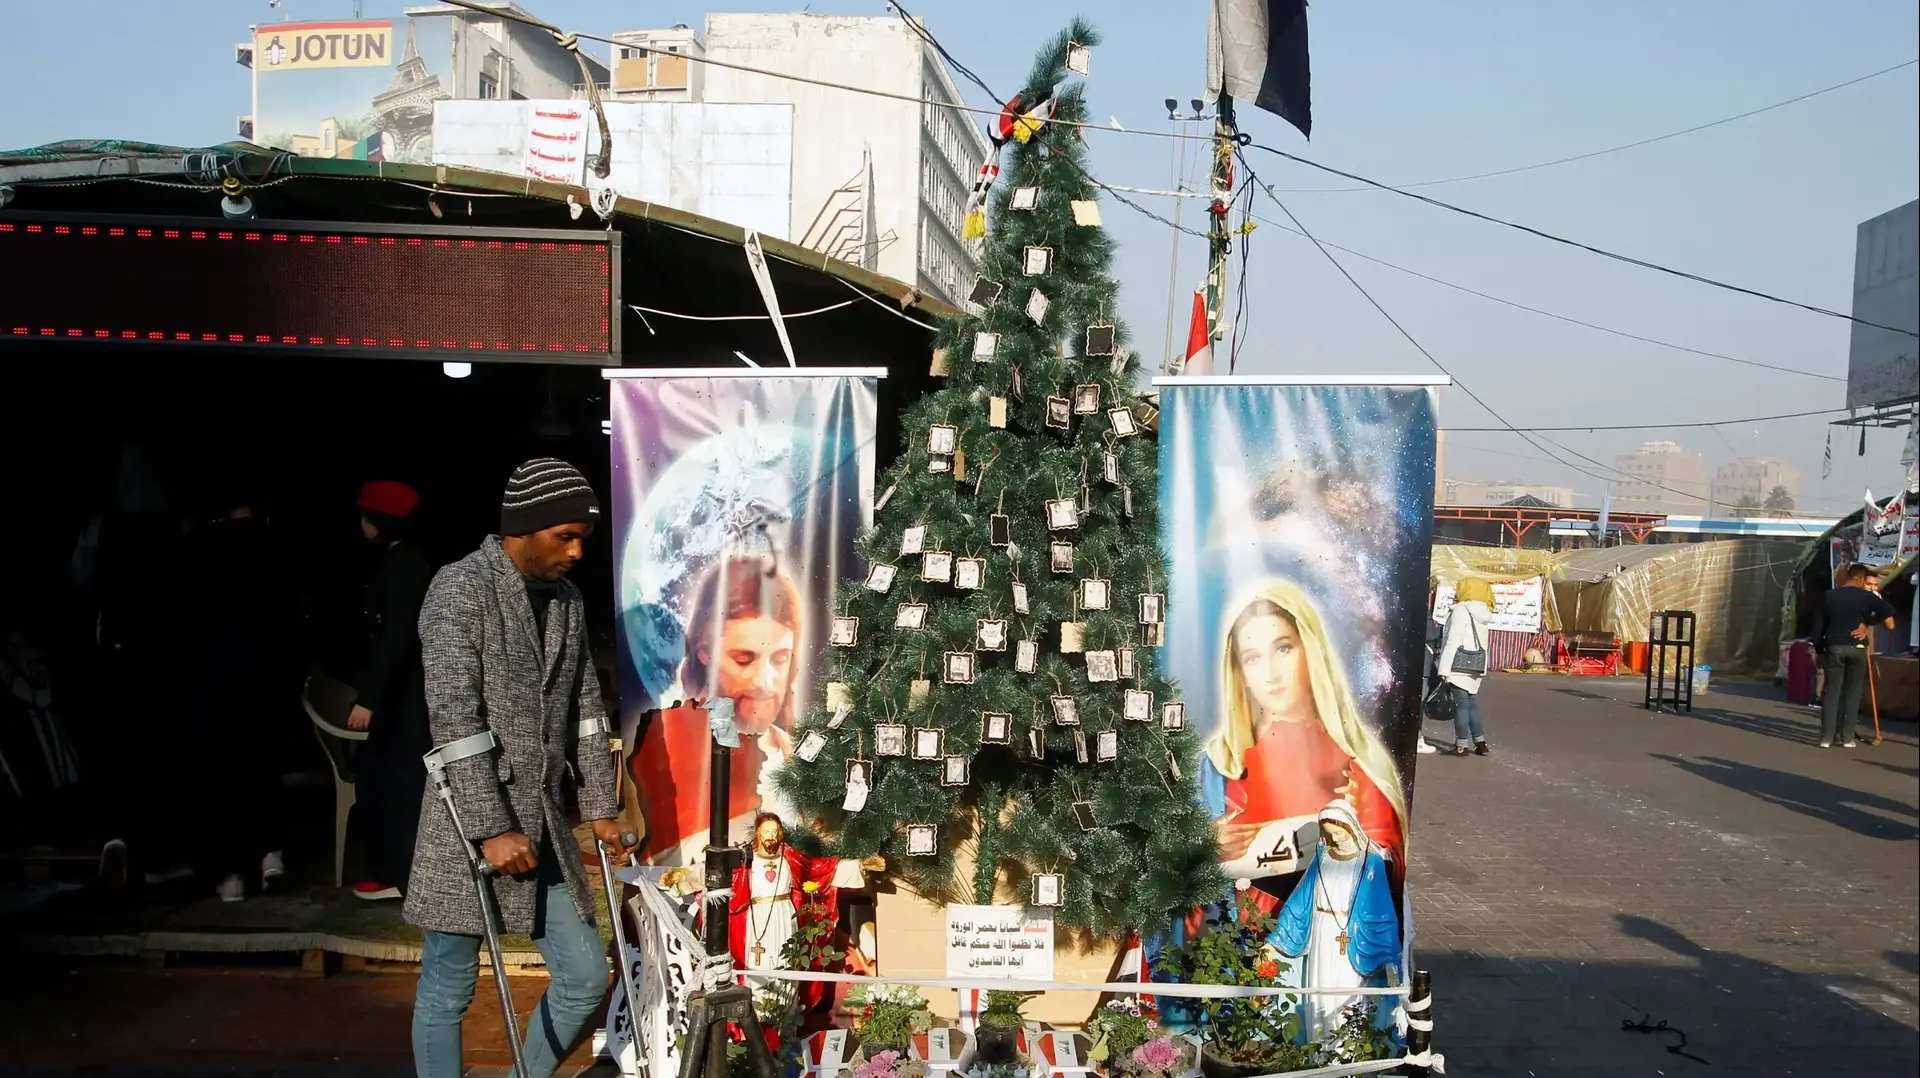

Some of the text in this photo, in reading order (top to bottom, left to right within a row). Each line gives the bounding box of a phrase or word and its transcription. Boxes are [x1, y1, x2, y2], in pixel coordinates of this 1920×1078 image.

[291, 33, 385, 63] JOTUN
[993, 938, 1006, 951] الله
[969, 955, 1006, 969] الفاسدون
